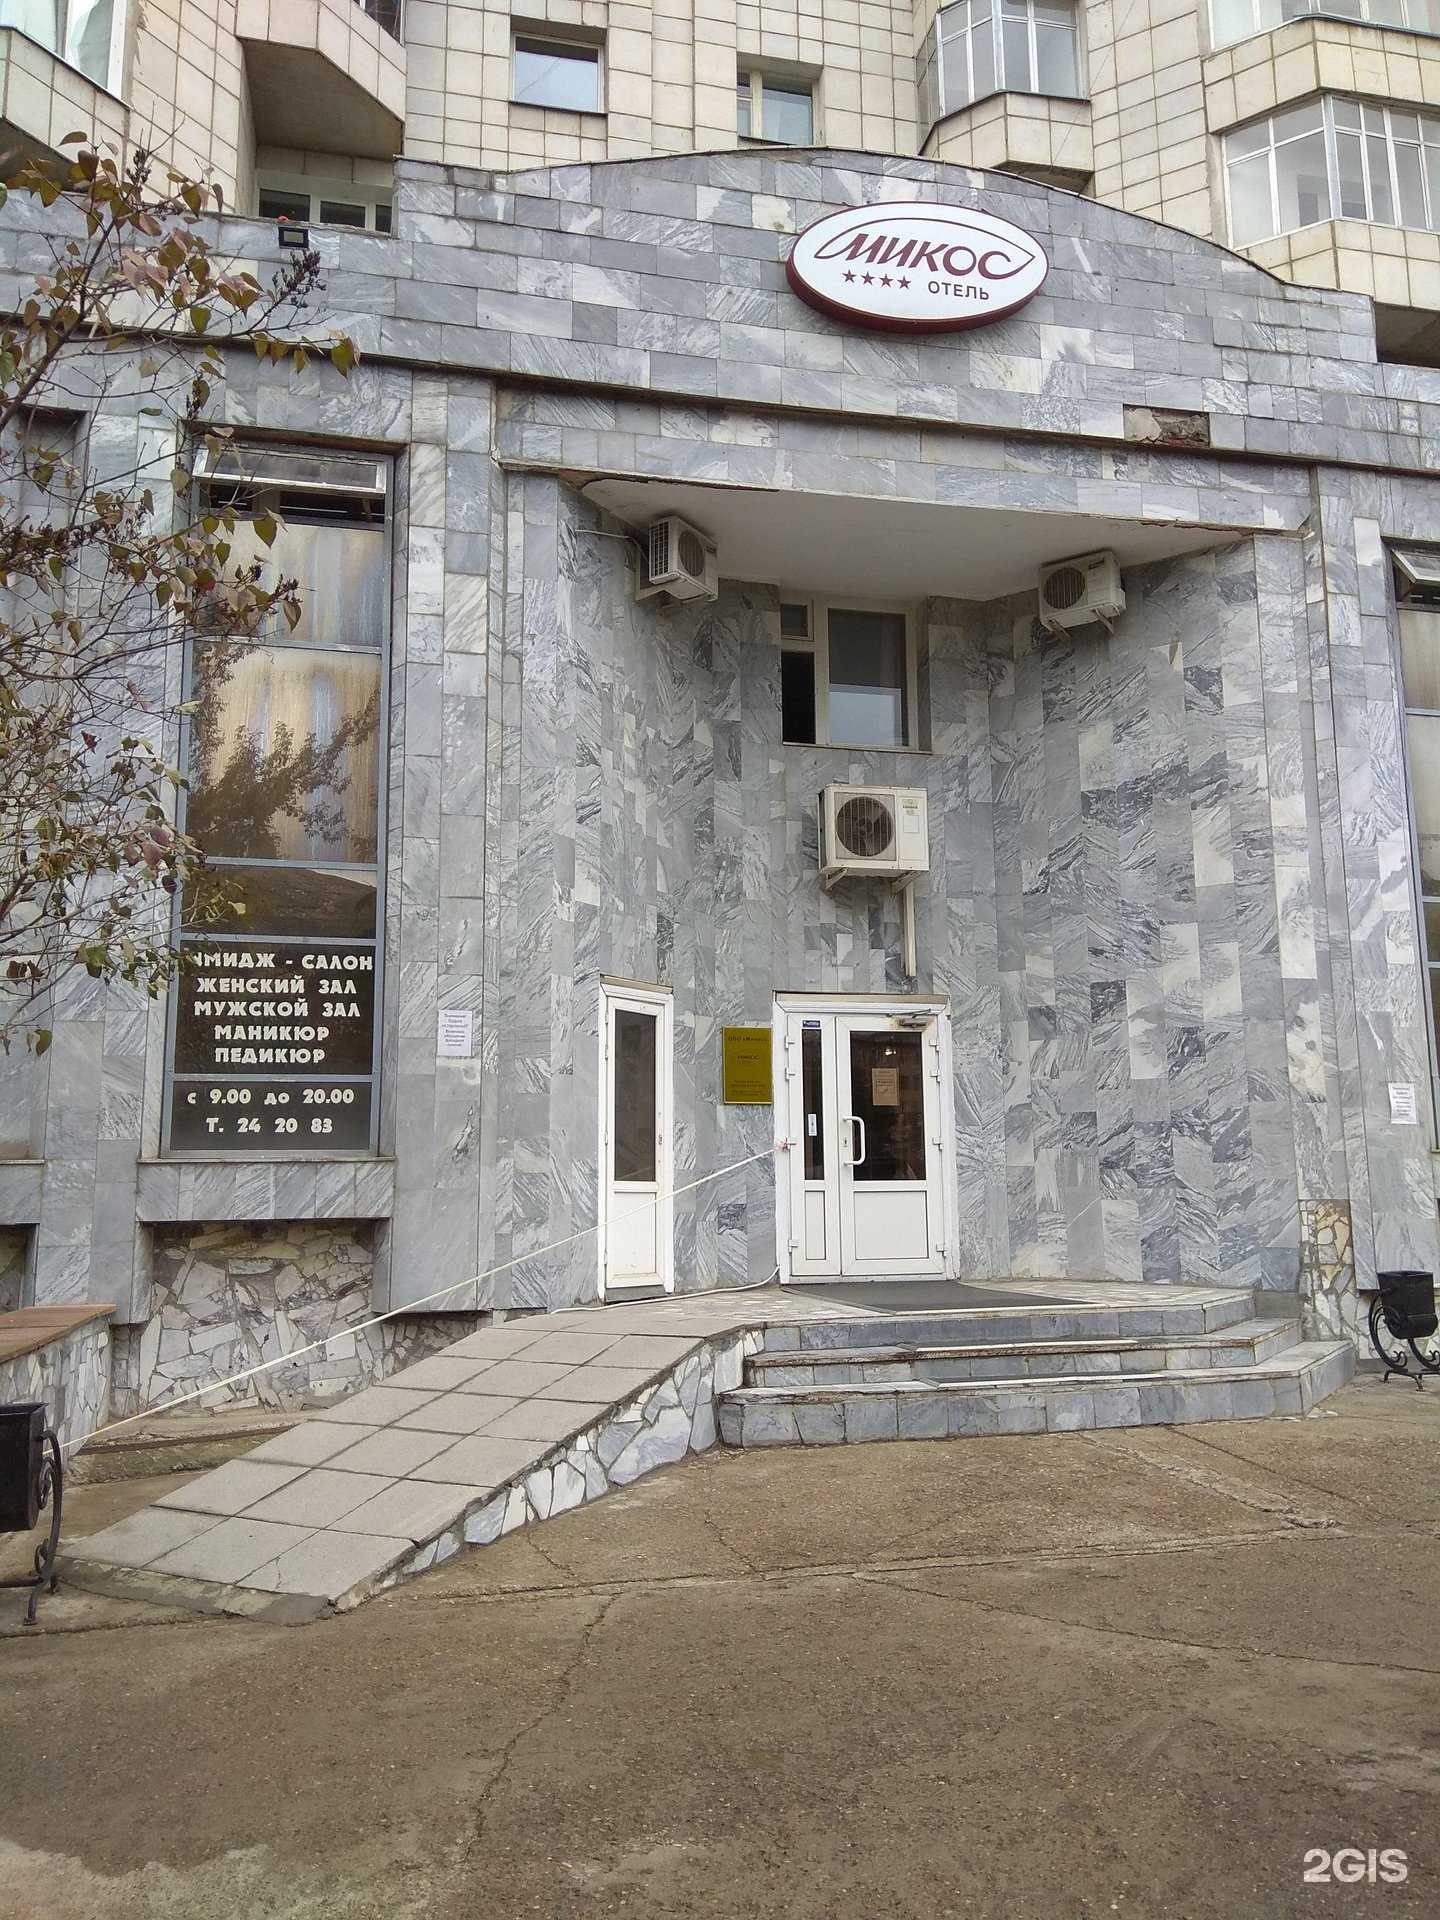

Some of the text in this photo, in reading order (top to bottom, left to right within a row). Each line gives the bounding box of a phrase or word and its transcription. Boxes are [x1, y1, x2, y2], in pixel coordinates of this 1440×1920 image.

[842, 232, 1020, 281] МИКОС
[928, 280, 990, 300] ОТЕЛЬ
[301, 954, 373, 970] САЛОН
[196, 975, 357, 994] ЖЕНСКИЙ ЗАЛ
[194, 998, 360, 1017] МУЖСКОЙ ЗАЛ
[214, 1025, 330, 1041] МАНИКЮР
[215, 1047, 326, 1064] ПЕДИКЮР
[209, 1088, 252, 1104] 9.00
[302, 1088, 354, 1104] 20.00
[206, 1117, 333, 1133] Т. 24 20 83
